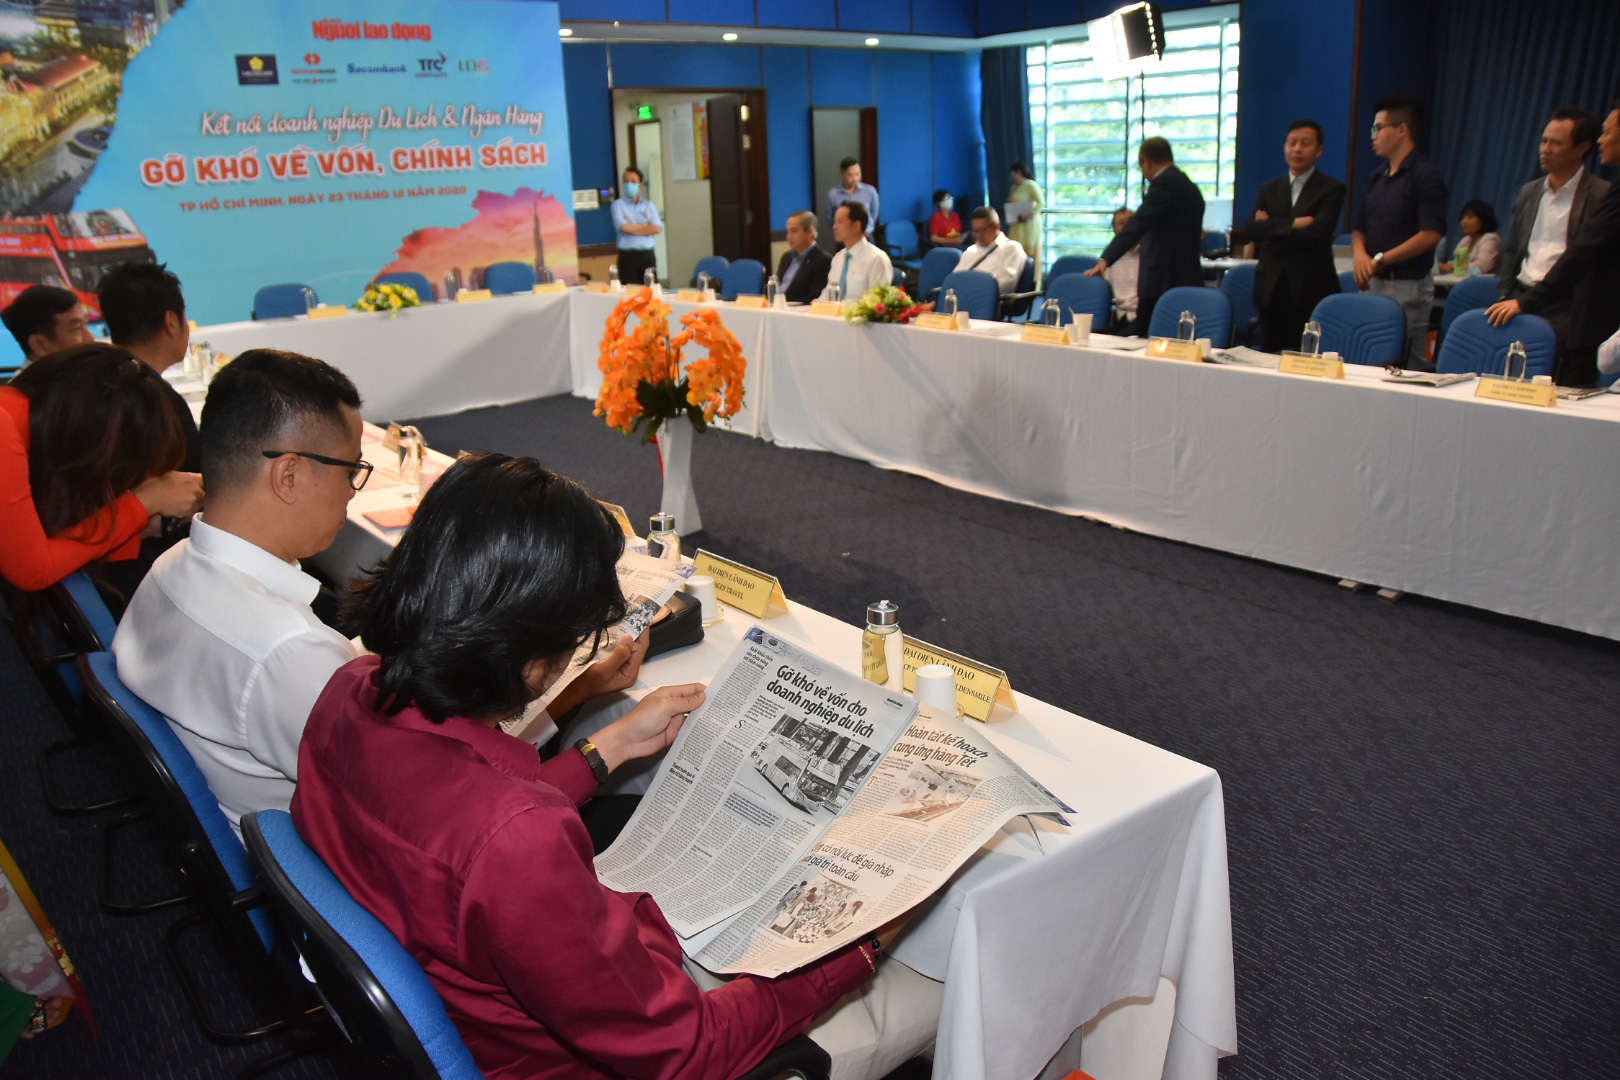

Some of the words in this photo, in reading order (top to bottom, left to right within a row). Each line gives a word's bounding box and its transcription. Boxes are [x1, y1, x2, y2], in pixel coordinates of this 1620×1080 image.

[363, 21, 389, 40] lao
[346, 62, 407, 75] Sacombank
[418, 58, 443, 71] TTC
[201, 110, 234, 136] Kết
[235, 113, 264, 134] nối
[267, 105, 320, 133] doanh
[322, 104, 374, 144] nghiệp
[442, 104, 459, 128] &
[461, 103, 502, 139] Ngân
[505, 103, 545, 137] Hàng
[141, 153, 187, 186] GỠ
[195, 147, 260, 183] KHÓ
[266, 145, 314, 178] VỀ
[317, 144, 385, 176] VỐN,
[391, 139, 473, 171] CHÍNH
[479, 137, 547, 168] SÁCH
[178, 201, 197, 212] TP
[200, 197, 221, 210] HỒ
[223, 195, 246, 210] CHÍ
[249, 196, 285, 208] MINH,
[288, 192, 325, 205] NGÀY
[327, 191, 344, 202] 23
[347, 188, 390, 200] THÁNG
[392, 188, 405, 199] 12
[407, 186, 436, 197] NĂM
[438, 185, 467, 195] 2020
[707, 564, 717, 574] ĐẠI
[742, 579, 755, 590] ĐẠO
[714, 581, 727, 591] AGES
[726, 586, 744, 600] TRAVEL
[903, 646, 917, 659] ĐẠI
[916, 651, 935, 665] DIỆN
[956, 668, 975, 681] ĐẠO
[776, 664, 795, 682] Gỡ
[791, 672, 816, 693] khó
[814, 685, 832, 700] về
[828, 692, 848, 710] vốn
[846, 700, 868, 717] cho
[954, 683, 991, 703] LDENSMILE
[766, 679, 802, 706] doanh
[799, 698, 840, 725] nghiệp
[837, 715, 854, 731] du
[851, 719, 875, 739] lịch
[904, 724, 928, 740] Hoàn
[926, 730, 945, 743] tất
[941, 733, 963, 746] kế
[893, 742, 915, 757] cung
[912, 743, 934, 761] ứng
[932, 746, 959, 767] hàng
[956, 754, 977, 768] Tết
[821, 843, 834, 853] có
[840, 849, 854, 861] lực
[807, 856, 825, 866] giá
[828, 862, 846, 877] toàn
[844, 869, 861, 882] cầu
[851, 853, 867, 865] để
[858, 858, 874, 870] gia
[872, 862, 895, 879] nhập
